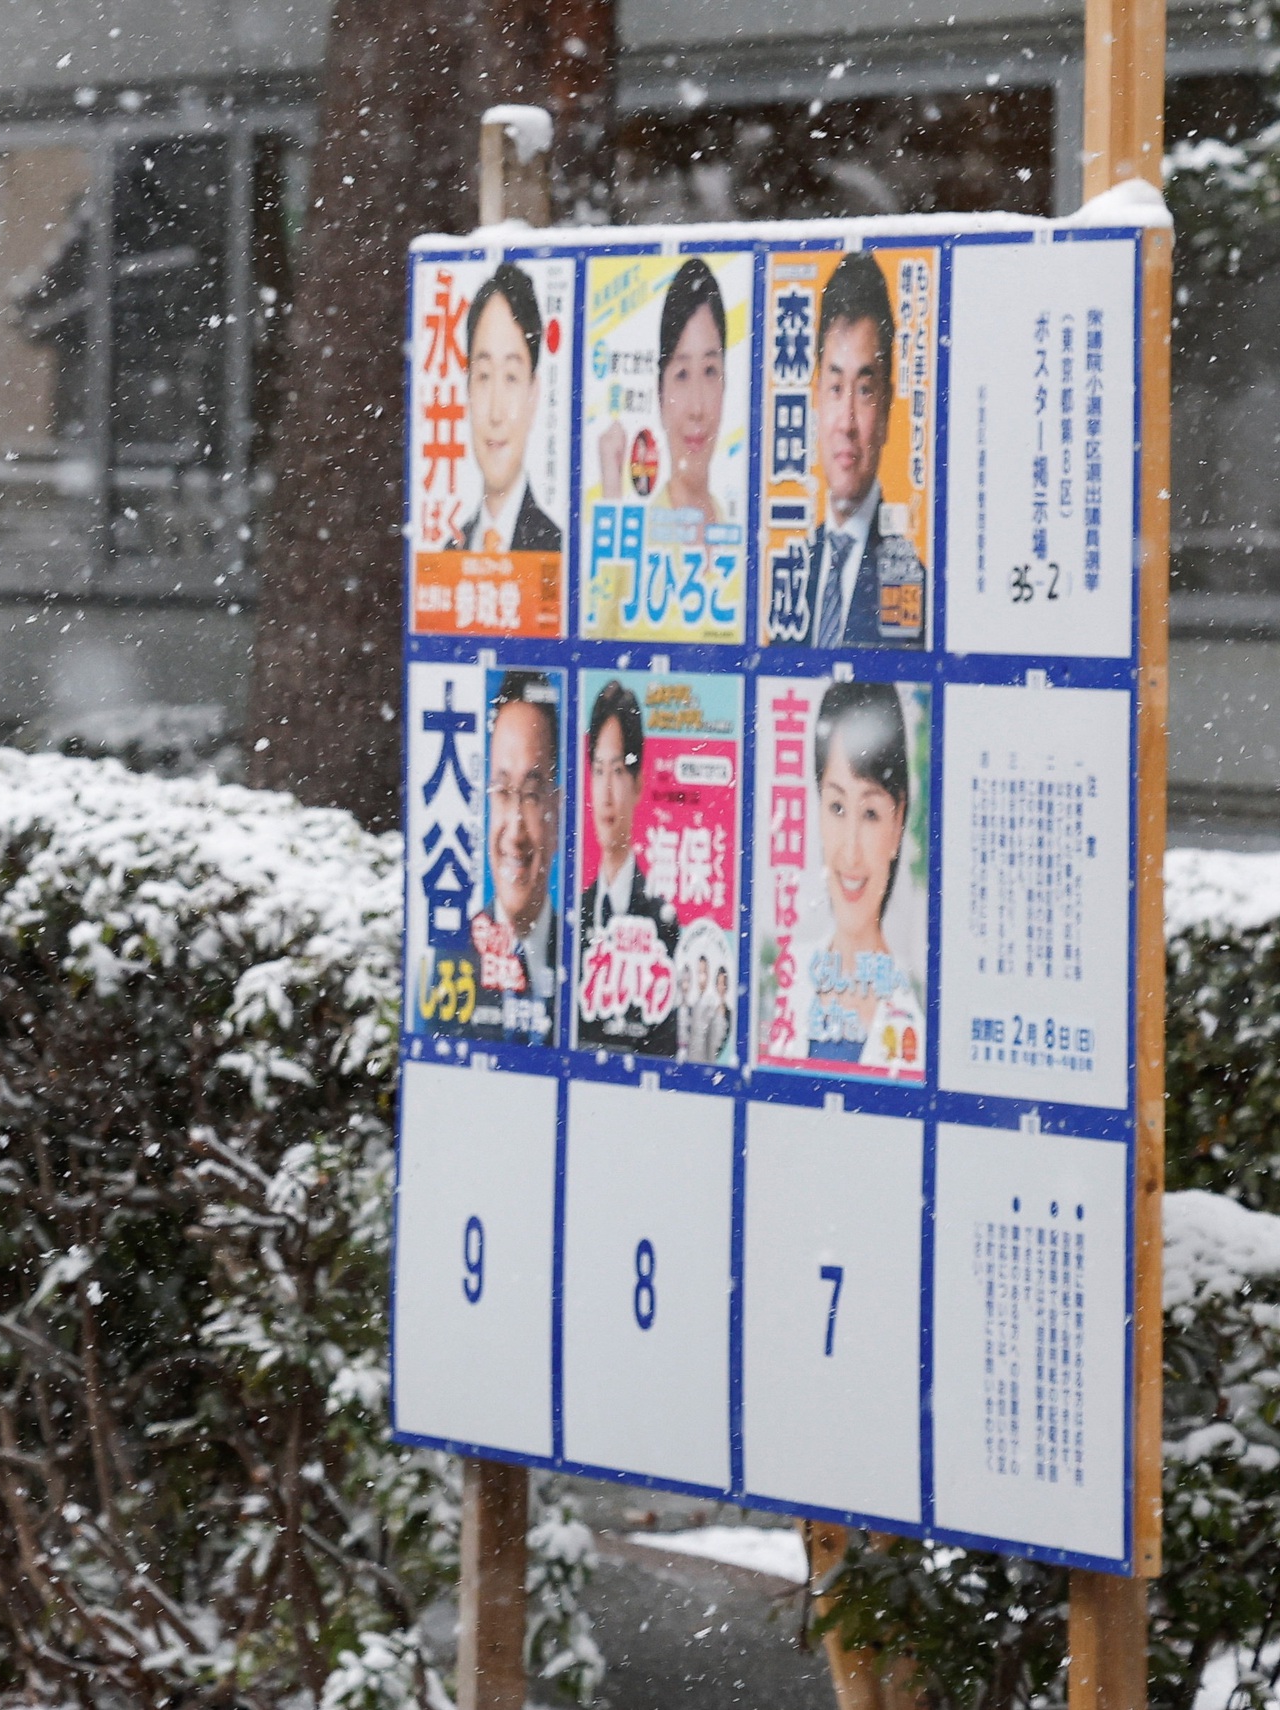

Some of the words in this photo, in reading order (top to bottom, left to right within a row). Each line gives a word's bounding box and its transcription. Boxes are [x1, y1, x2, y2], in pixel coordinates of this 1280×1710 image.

[422, 268, 469, 546] 永井ばく
[768, 290, 810, 635] 森田一成
[1032, 311, 1051, 561] ポスター掲示場
[588, 506, 737, 623] 門ひろこ
[422, 680, 478, 950] 大谷
[770, 688, 811, 1045] 吉田はるみ
[419, 957, 477, 1024] しろう
[583, 940, 673, 1014] れいわ
[464, 1215, 484, 1305] 9
[634, 1238, 656, 1331] 8
[820, 1265, 844, 1358] 7
